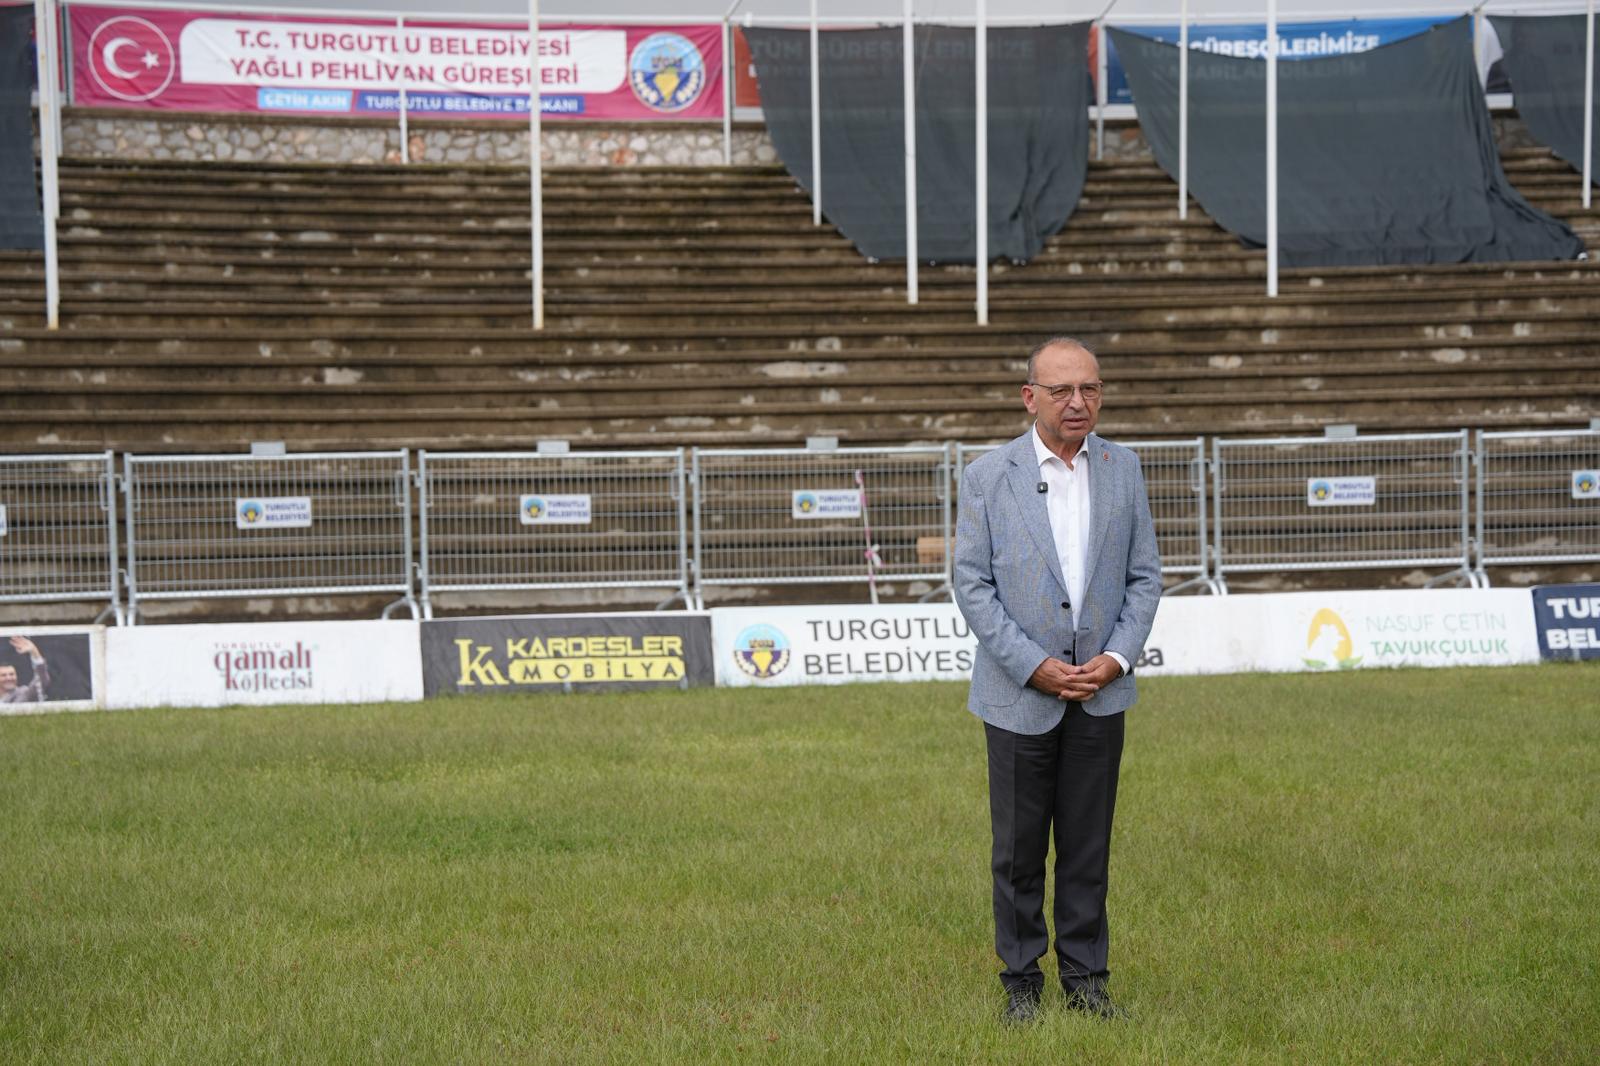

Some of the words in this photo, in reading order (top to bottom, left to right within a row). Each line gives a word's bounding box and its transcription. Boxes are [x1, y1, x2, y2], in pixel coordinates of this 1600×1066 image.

[235, 28, 280, 49] T.C.
[287, 31, 422, 54] TURGUTLU
[430, 33, 571, 57] BELEDİYESİ
[230, 54, 304, 79] YAĞLI
[311, 58, 435, 83] PEHLİVAN
[806, 617, 970, 641] TURGUTLU
[1365, 614, 1435, 633] NASUF
[1443, 611, 1507, 635] ÇETİN
[506, 636, 684, 658] KARDESLER
[1370, 639, 1509, 656] TAVUKÇULUK
[523, 661, 678, 681] MOBİLYA
[804, 646, 975, 676] BELEDİYES
